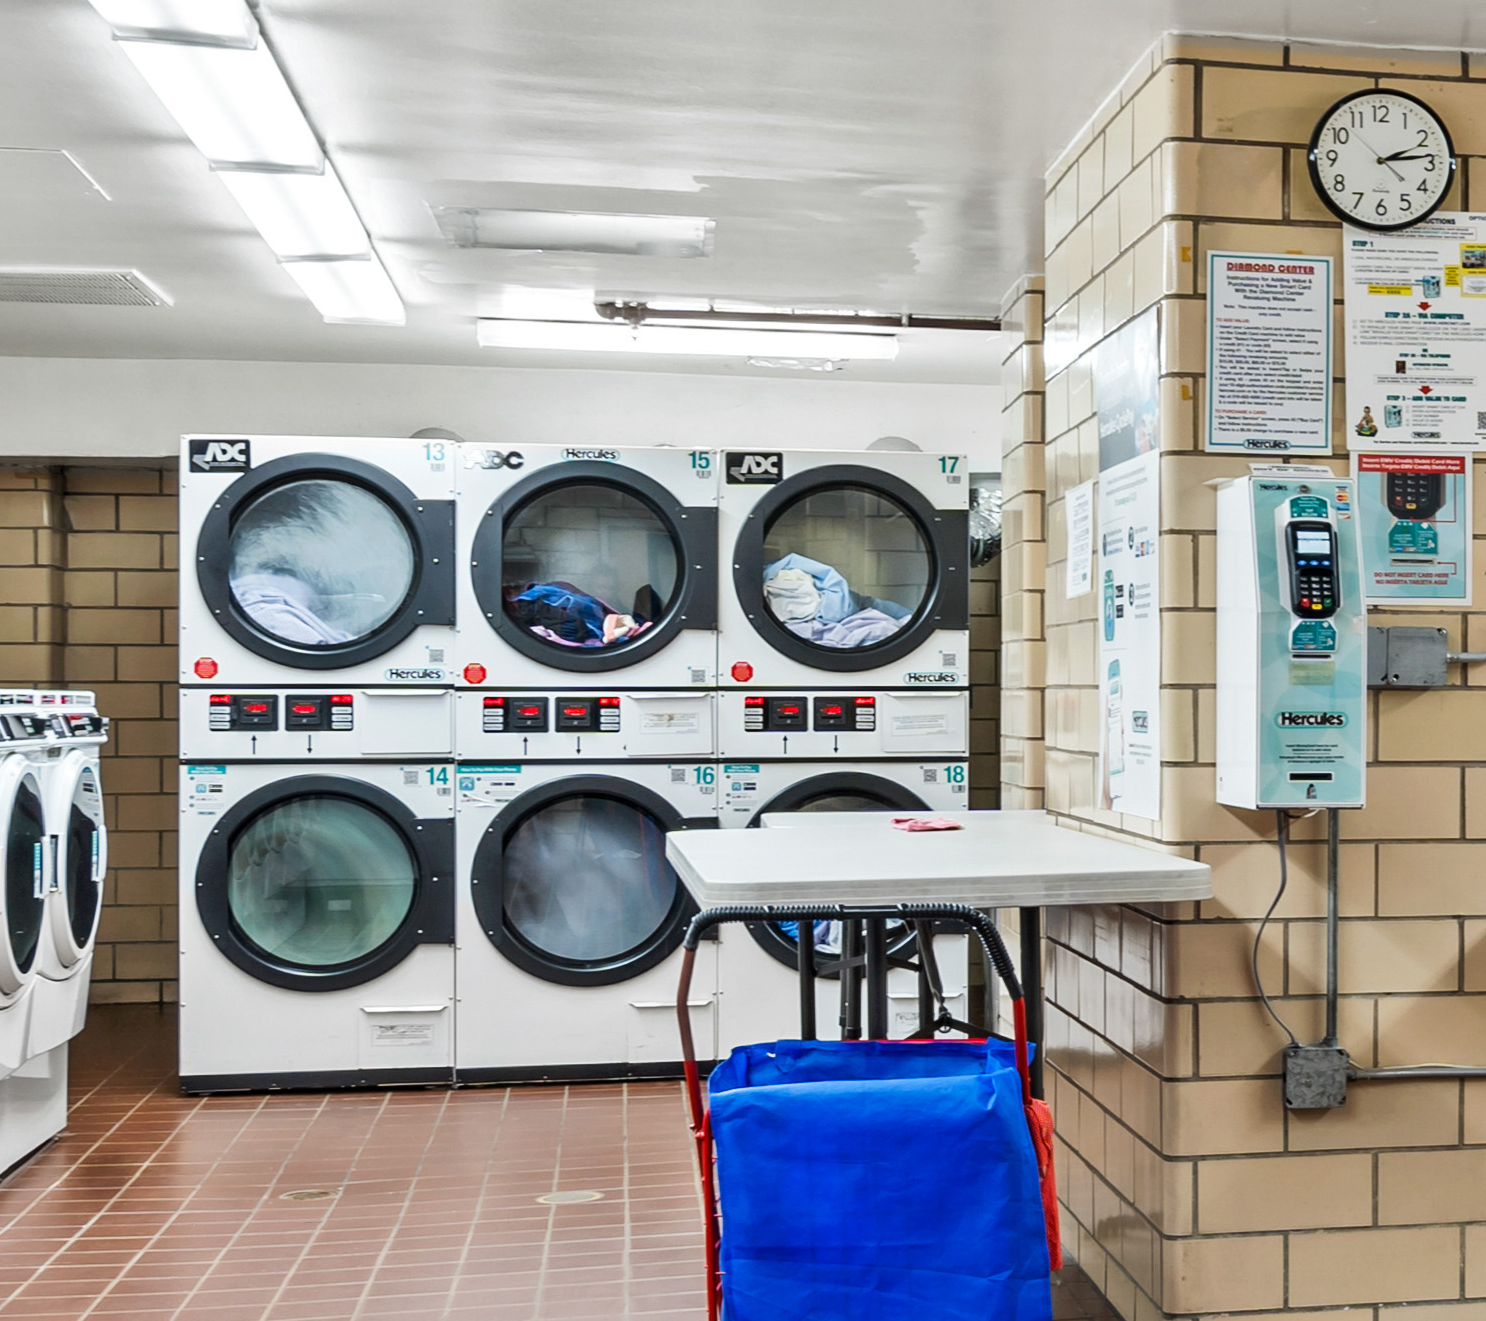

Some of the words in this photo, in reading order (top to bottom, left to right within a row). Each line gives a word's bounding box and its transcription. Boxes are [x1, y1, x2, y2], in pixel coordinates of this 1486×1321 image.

[1350, 111, 1363, 128] 11
[1372, 105, 1390, 123] 12
[1402, 113, 1407, 129] 1
[1332, 127, 1349, 145] 10
[1416, 129, 1429, 147] 2
[1326, 149, 1338, 167] 9
[1424, 154, 1435, 172] 3
[1334, 174, 1345, 192] 8
[1416, 178, 1429, 194] 4
[1352, 192, 1364, 210] 7
[1375, 198, 1387, 216] 6
[1399, 194, 1411, 211] 5
[1226, 262, 1275, 272] DIAMOND
[1278, 264, 1315, 275] CENTER
[1227, 281, 1259, 289] Purchasing
[204, 442, 247, 462] ADC
[425, 443, 445, 461] 13
[1247, 439, 1288, 449] Hercules
[464, 450, 524, 469] ADC
[566, 448, 616, 460] Hercules
[688, 451, 710, 469] 15
[740, 455, 778, 474] ADC
[938, 456, 960, 474] 17
[389, 668, 442, 679] Hercules
[908, 672, 956, 682] Hercules
[1281, 712, 1343, 726] Hercules
[426, 767, 449, 785] 14
[693, 766, 715, 784] 16
[944, 766, 965, 783] 18
